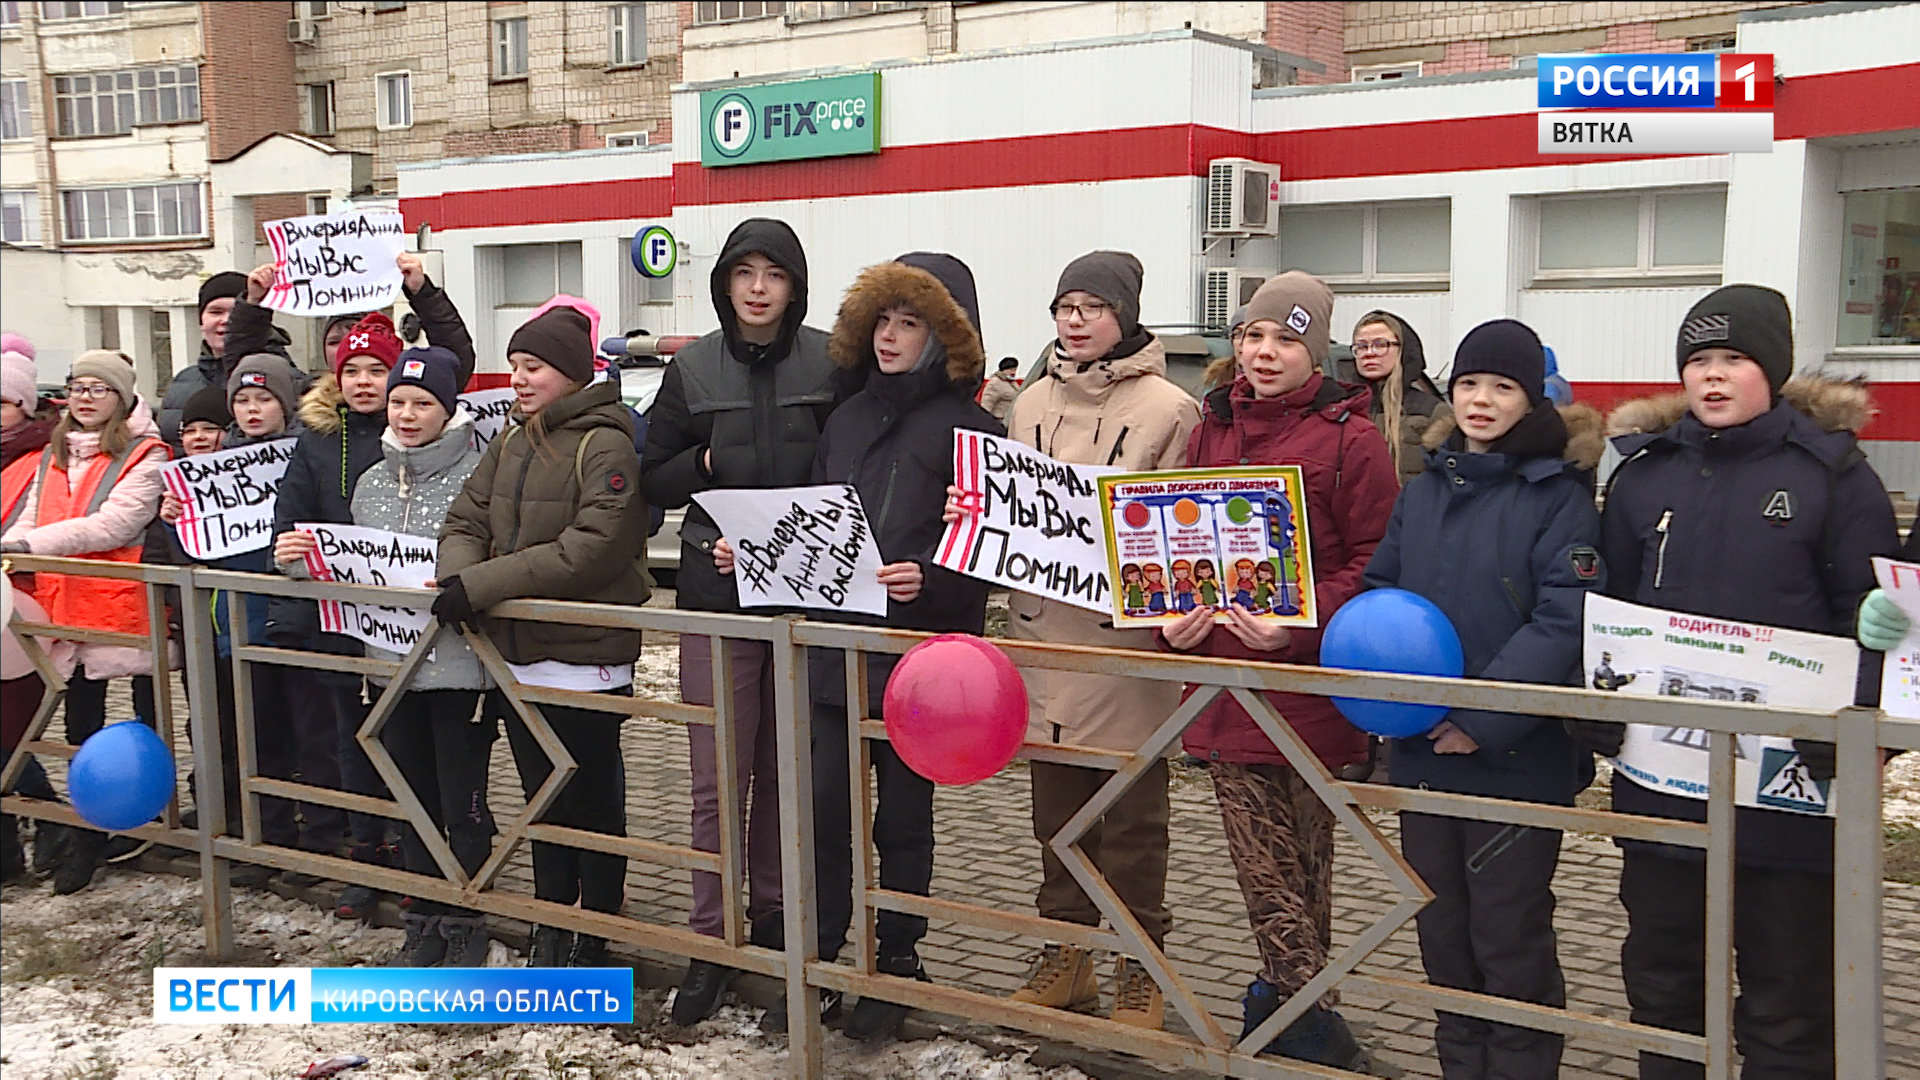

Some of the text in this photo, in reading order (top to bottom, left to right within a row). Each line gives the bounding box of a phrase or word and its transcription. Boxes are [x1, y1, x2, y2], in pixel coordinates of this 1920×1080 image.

[816, 97, 866, 124] price
[1121, 479, 1280, 496] ПРАВИЛА ДОРОЖНОГО ДВИЖЕНИЯ
[203, 513, 275, 553] Помн
[341, 601, 422, 646] Помни
[1592, 623, 1608, 634] Не
[1610, 625, 1653, 638] садись
[1664, 633, 1725, 651] пьяным
[1728, 643, 1745, 654] за
[1665, 777, 1710, 794] люде
